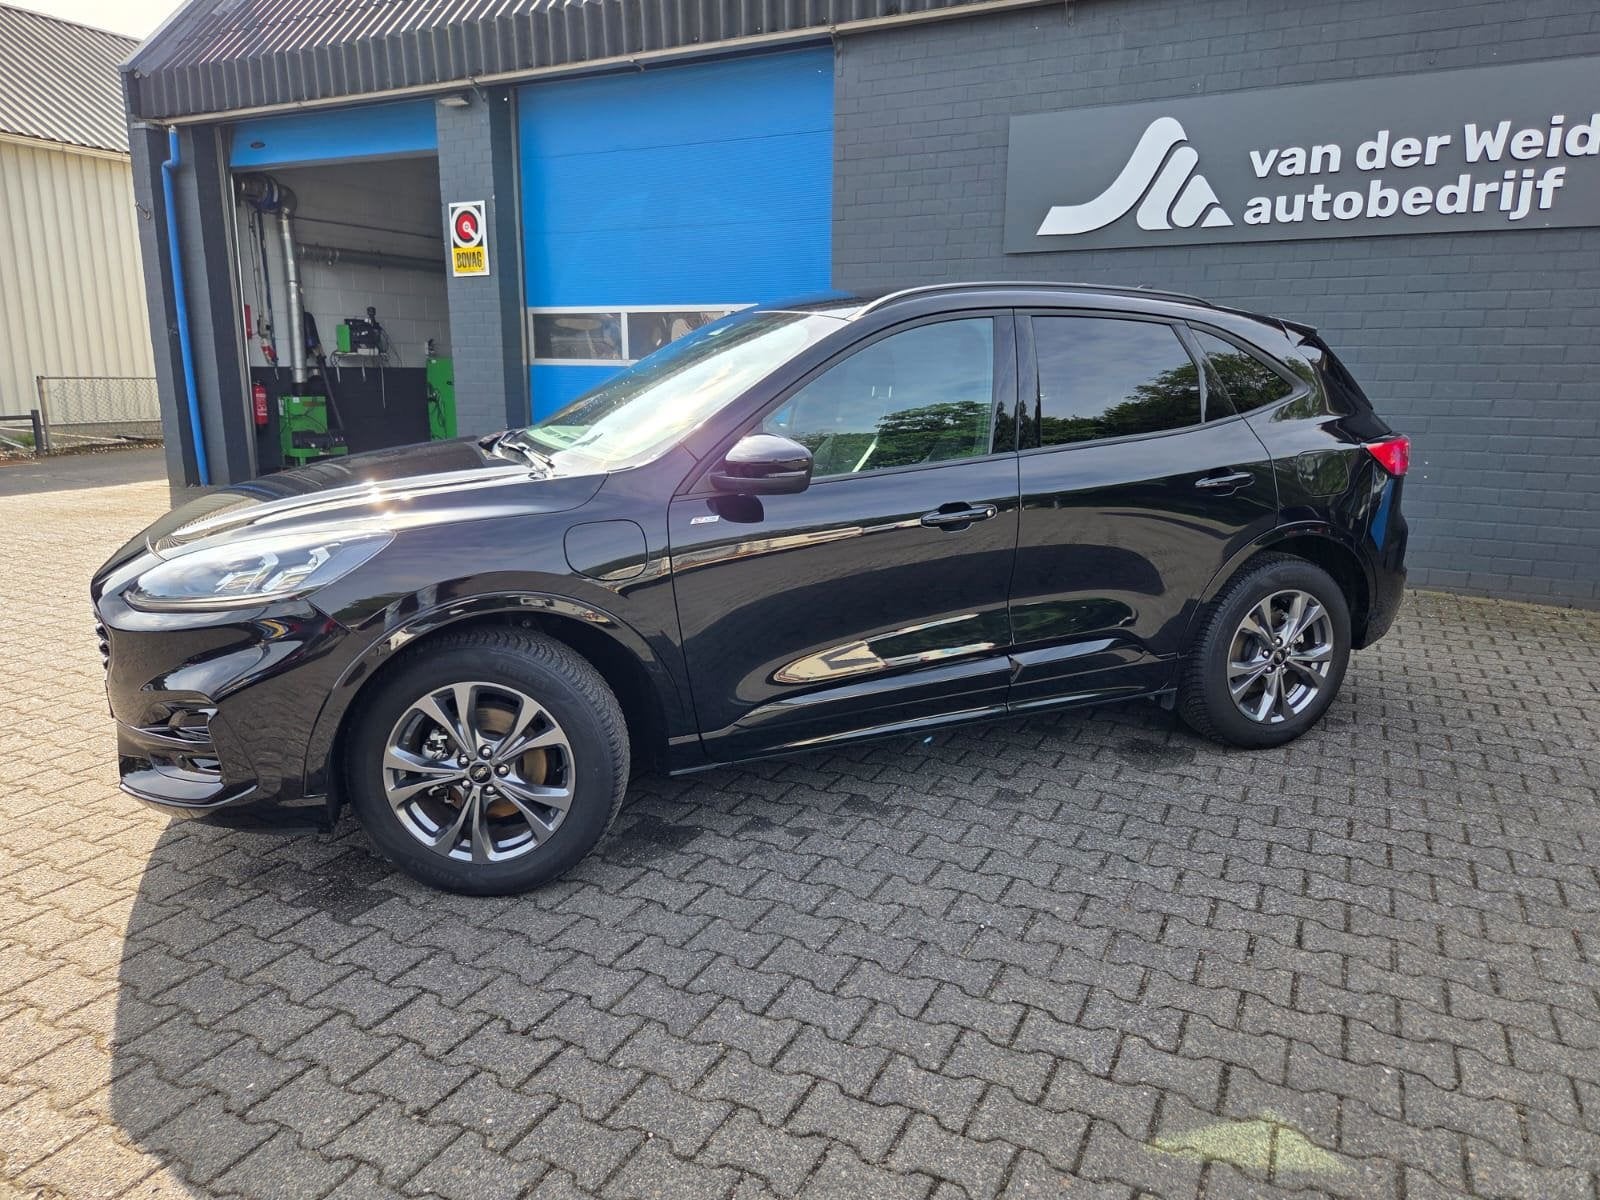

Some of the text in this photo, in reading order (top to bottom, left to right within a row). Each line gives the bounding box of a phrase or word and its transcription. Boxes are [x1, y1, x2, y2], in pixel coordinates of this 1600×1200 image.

[1249, 113, 1600, 178] van der Weid
[1243, 166, 1566, 225] autobedrijf
[456, 251, 483, 269] BOVAG
